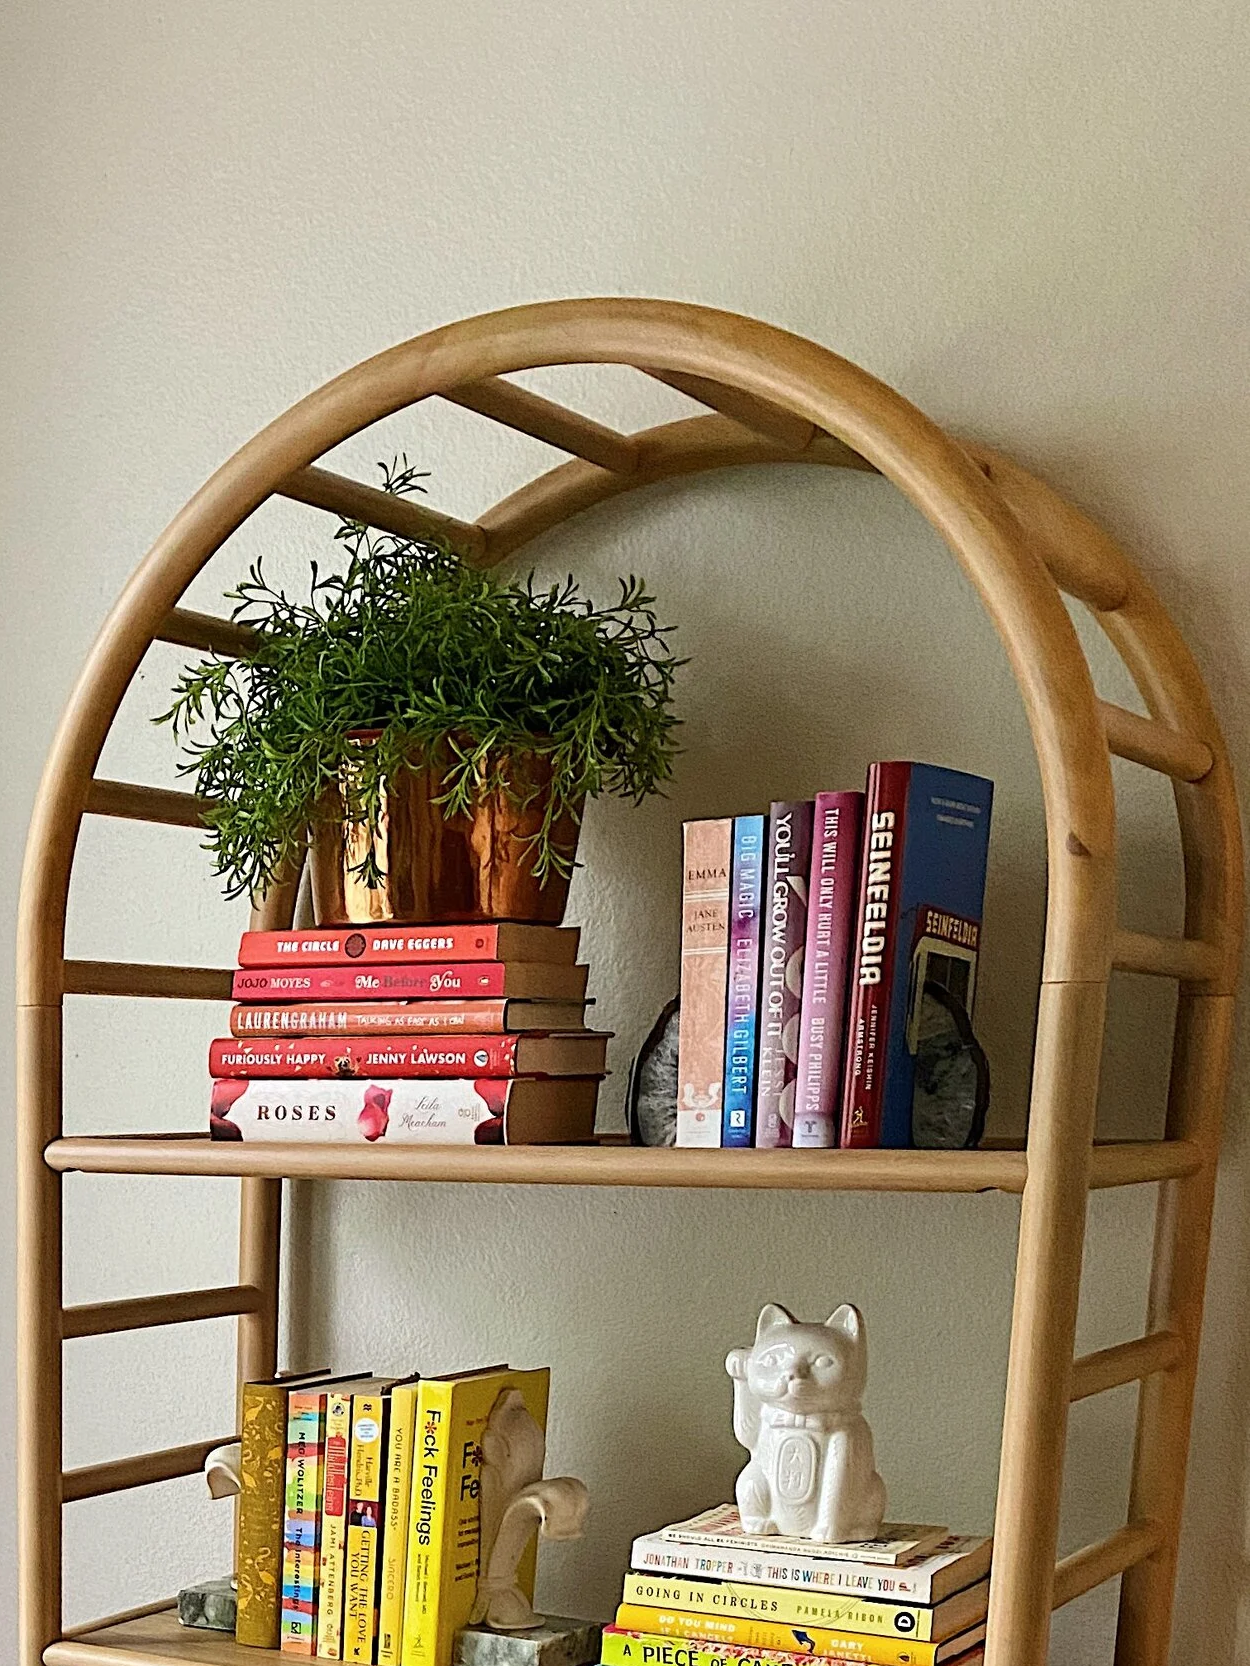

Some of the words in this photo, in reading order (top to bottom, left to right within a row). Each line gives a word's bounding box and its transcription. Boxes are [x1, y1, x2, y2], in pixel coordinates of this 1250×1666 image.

[823, 808, 840, 838] THIS
[740, 835, 757, 862] BIG
[821, 841, 837, 874] WILL
[688, 868, 727, 881] EMMA
[738, 868, 755, 919] MAGIC
[818, 879, 836, 909] ONLY
[859, 811, 895, 986] SEINFELDIA
[686, 922, 725, 933] AUSTEN
[694, 909, 719, 919] JANE
[771, 881, 789, 944] GROW
[925, 910, 979, 946] SEINFELDIA
[276, 941, 298, 952] THE
[301, 940, 339, 952] CIRCLE
[372, 939, 404, 951] DAVE
[407, 937, 454, 950] EGGERS
[815, 913, 833, 946] HURT
[769, 947, 786, 990] OUT
[816, 950, 830, 958] A
[237, 978, 269, 989] JOJO
[270, 977, 311, 989] MOYES
[355, 975, 380, 989] Me
[429, 969, 461, 992] You
[734, 938, 753, 1023] ELIZABETH
[812, 962, 829, 1004] LITTLE
[768, 991, 785, 1022] OF
[810, 1017, 825, 1049] BUSY
[868, 1004, 878, 1050] JENNIFER
[221, 1053, 282, 1065] FURIOUSLY
[286, 1053, 326, 1065] HAPPY
[366, 1053, 407, 1065] JENNY
[410, 1053, 466, 1065] LAWSON
[731, 1029, 748, 1094] GILBERT
[854, 1018, 866, 1077] ARMSTRONG
[760, 1047, 773, 1097] KLEIN
[805, 1053, 823, 1112] PHILIPPS
[257, 1105, 336, 1121] ROSES
[297, 1431, 306, 1455] MEG
[394, 1427, 404, 1449] YOU
[393, 1454, 402, 1473] ARE
[296, 1459, 306, 1515] WOLITZER
[416, 1464, 438, 1545] Feelings
[329, 1524, 337, 1549] JAMI
[350, 1552, 360, 1579] YOU
[360, 1530, 371, 1582] GETTING
[326, 1553, 336, 1616] ATTENBERG
[643, 1553, 689, 1570] JONATHAN
[695, 1558, 734, 1574] TROPPER
[767, 1566, 788, 1580] THIS
[791, 1568, 800, 1581] IS
[803, 1569, 835, 1586] WHERE
[838, 1574, 842, 1586] I
[845, 1575, 874, 1590] LEAVE
[877, 1579, 896, 1592] YOU
[349, 1582, 359, 1618] WANT
[358, 1587, 369, 1609] THE
[636, 1586, 681, 1600] GOING
[689, 1591, 704, 1603] IN
[712, 1594, 778, 1612] CIRCLES
[796, 1605, 840, 1619] PAMELA
[357, 1613, 368, 1644] LOVE
[658, 1615, 675, 1624] DO
[678, 1617, 701, 1627] YOU
[704, 1619, 736, 1633] MIND
[622, 1644, 632, 1657] A
[830, 1639, 864, 1651] GARY
